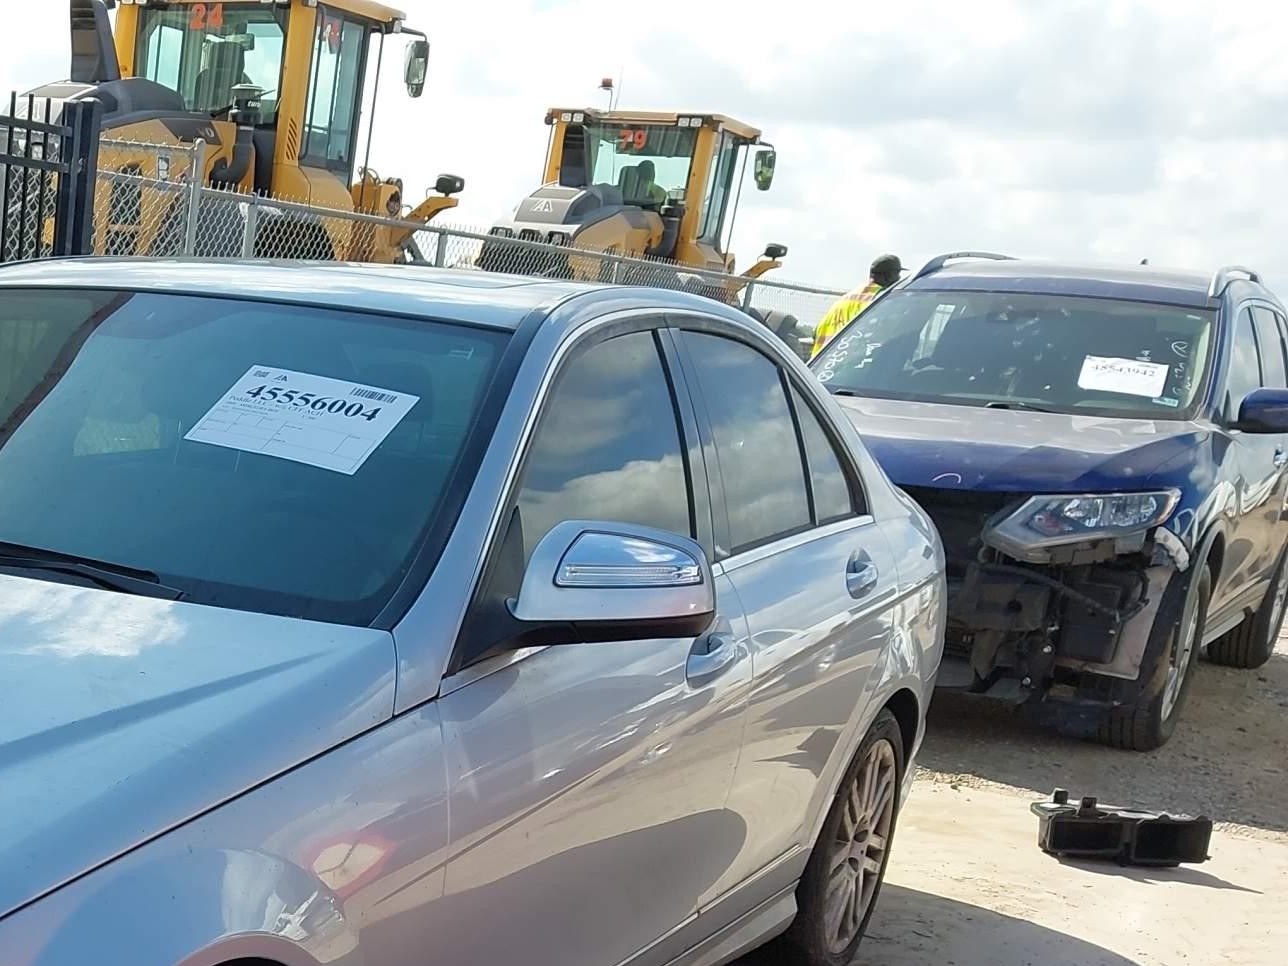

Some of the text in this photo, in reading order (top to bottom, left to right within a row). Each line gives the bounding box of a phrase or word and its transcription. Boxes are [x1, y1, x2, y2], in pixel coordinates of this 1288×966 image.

[189, 3, 224, 30] 24
[620, 128, 648, 150] 79
[246, 384, 382, 422] 45556004
